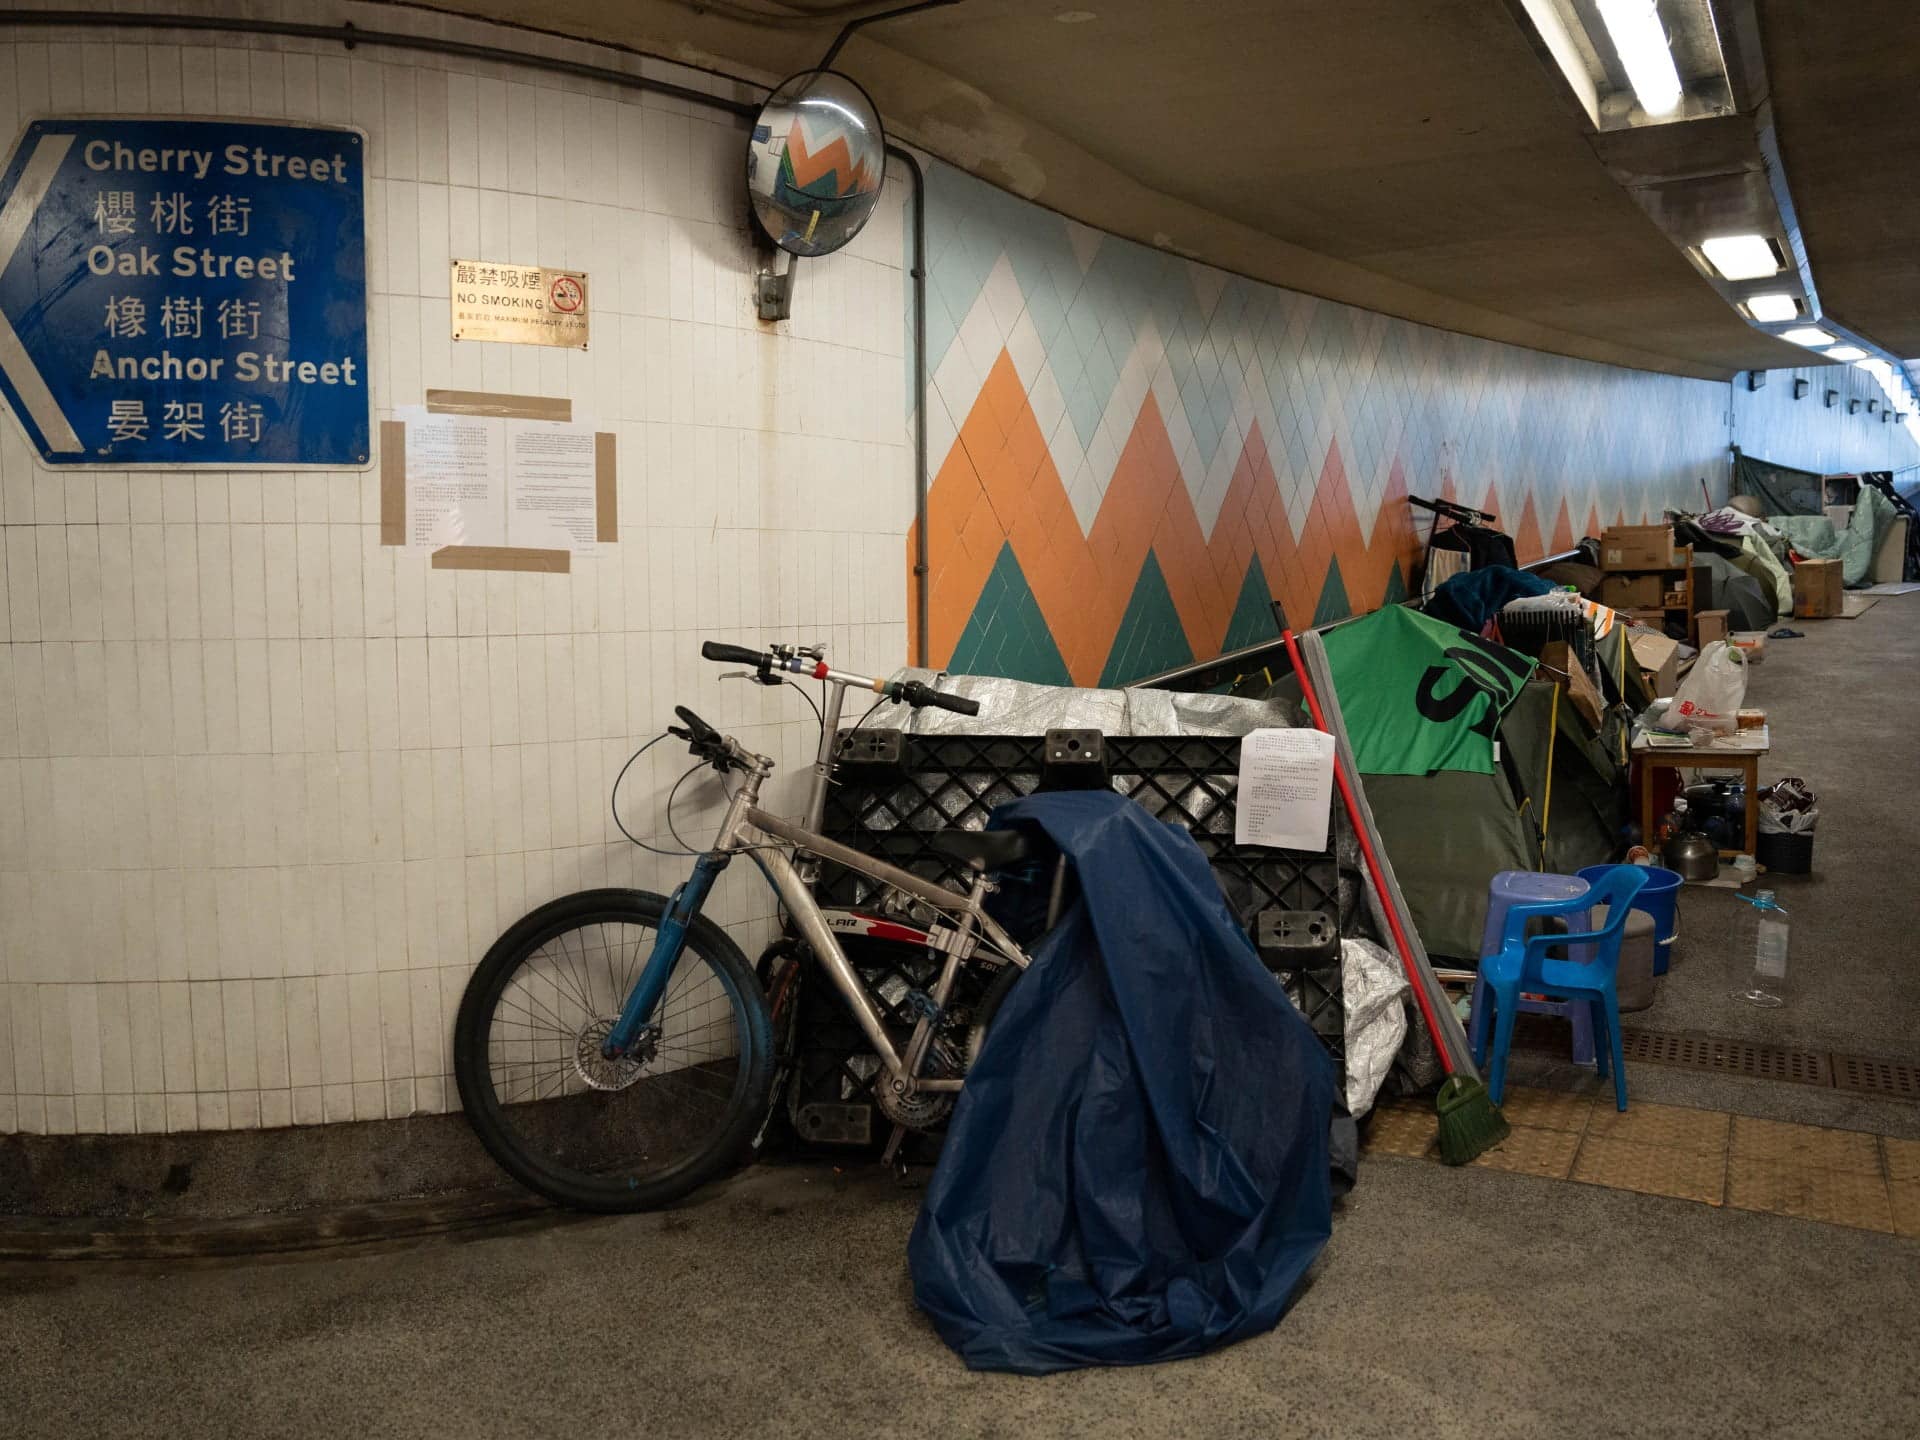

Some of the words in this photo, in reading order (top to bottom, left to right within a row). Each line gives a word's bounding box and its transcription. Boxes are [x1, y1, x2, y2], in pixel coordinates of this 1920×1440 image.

[84, 140, 212, 179] Cherry
[224, 144, 348, 183] Street
[94, 191, 251, 235] 櫻桃街
[88, 245, 160, 276] Oak
[172, 246, 296, 281] Street
[457, 265, 541, 290] 嚴禁吸煙
[104, 295, 262, 340] 橡樹街
[457, 293, 477, 304] NO
[481, 294, 544, 310] SMOKING
[90, 349, 224, 381] Anchor
[235, 352, 357, 386] Street
[106, 400, 264, 443] 晏架街
[826, 918, 857, 927] LAR
